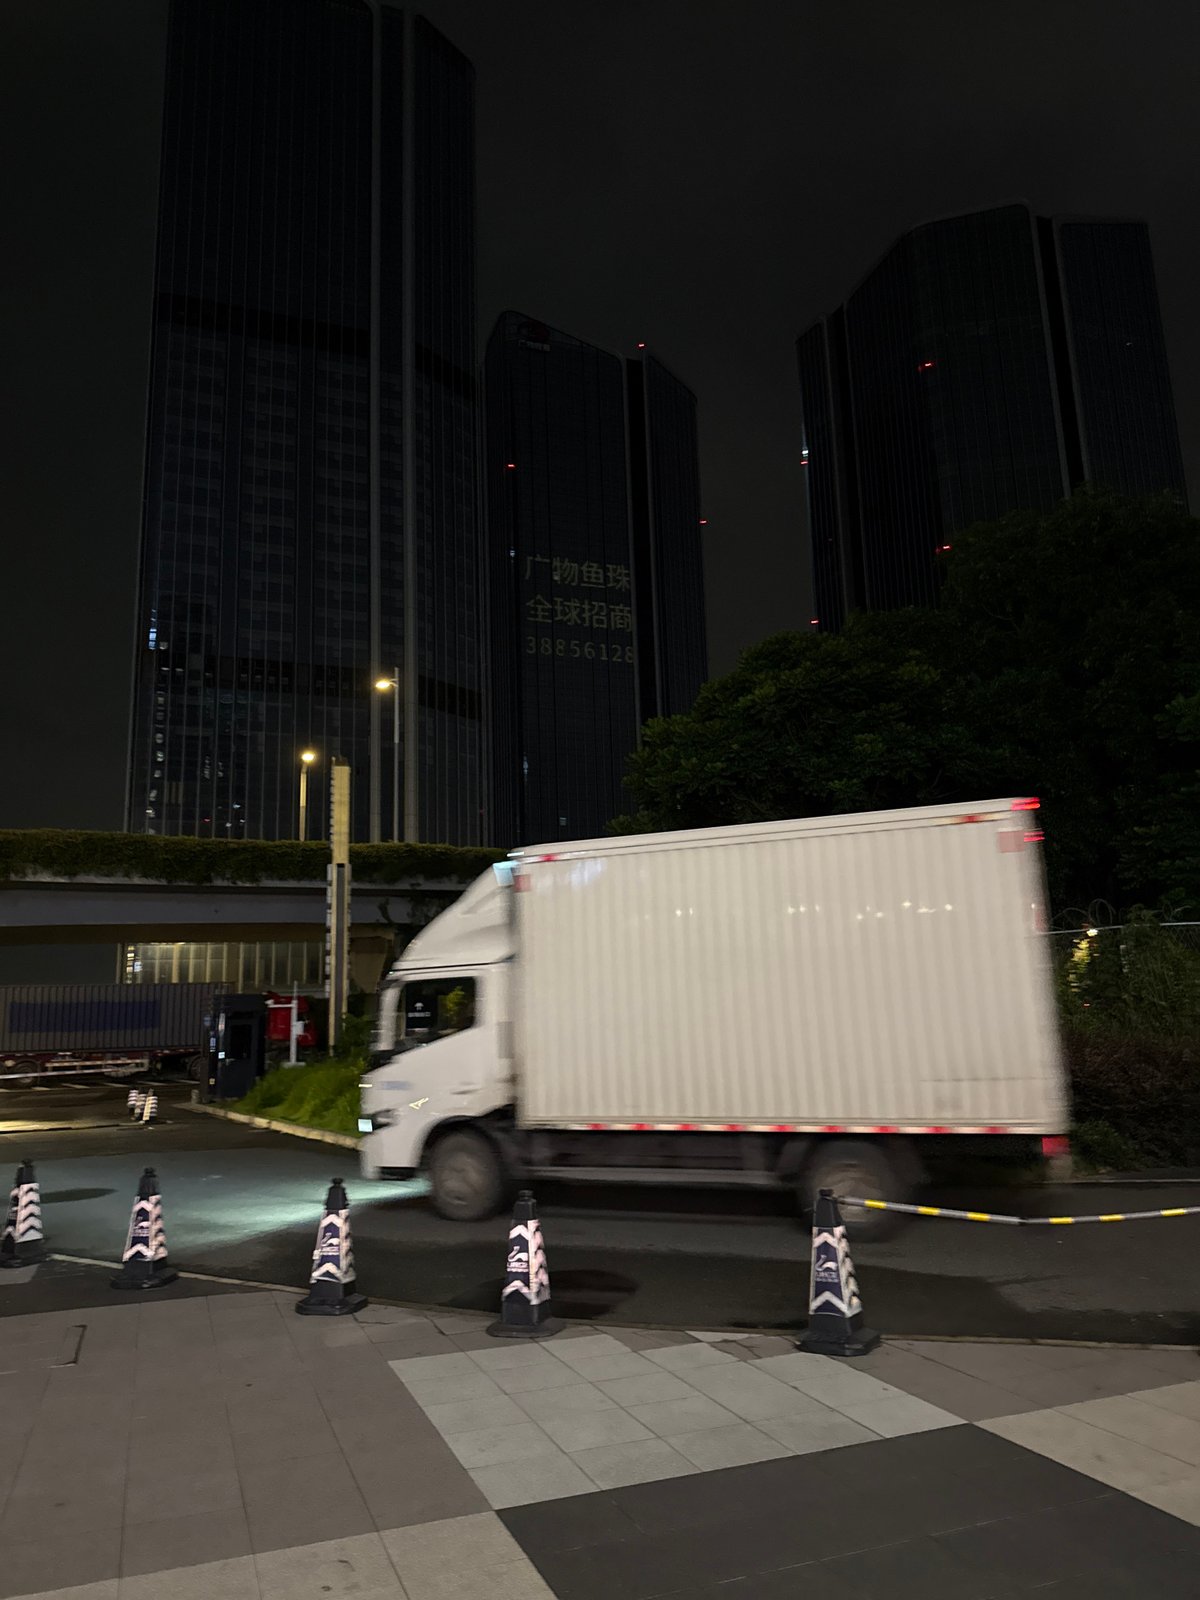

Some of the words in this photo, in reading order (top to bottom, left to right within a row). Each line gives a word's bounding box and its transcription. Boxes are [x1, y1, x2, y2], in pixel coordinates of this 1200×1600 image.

[525, 553, 631, 592] 广物鱼珠
[525, 594, 633, 633] 全球招商
[526, 636, 635, 663] 38856128
